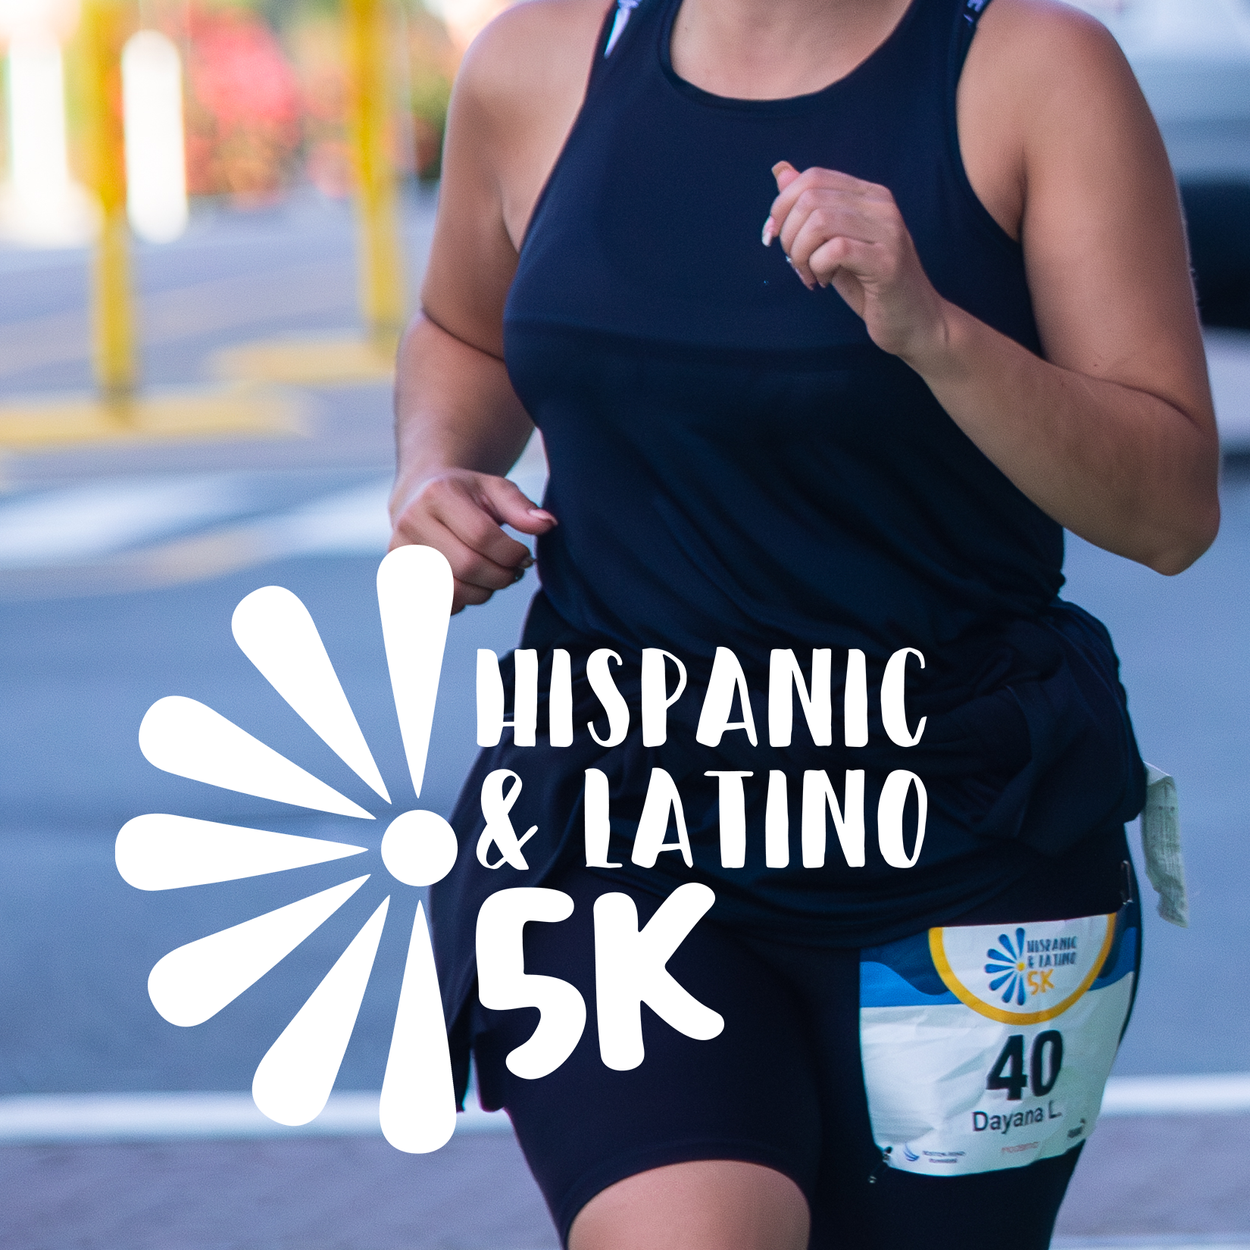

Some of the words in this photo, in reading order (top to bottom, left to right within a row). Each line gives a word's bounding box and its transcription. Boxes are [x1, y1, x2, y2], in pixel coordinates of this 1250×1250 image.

[1026, 935, 1078, 954] HISPANIC
[1038, 951, 1077, 968] LATINO
[1026, 968, 1055, 996] 5K
[986, 1029, 1064, 1101] 40
[972, 1107, 1044, 1135] Dayana
[1047, 1100, 1063, 1120] L.
